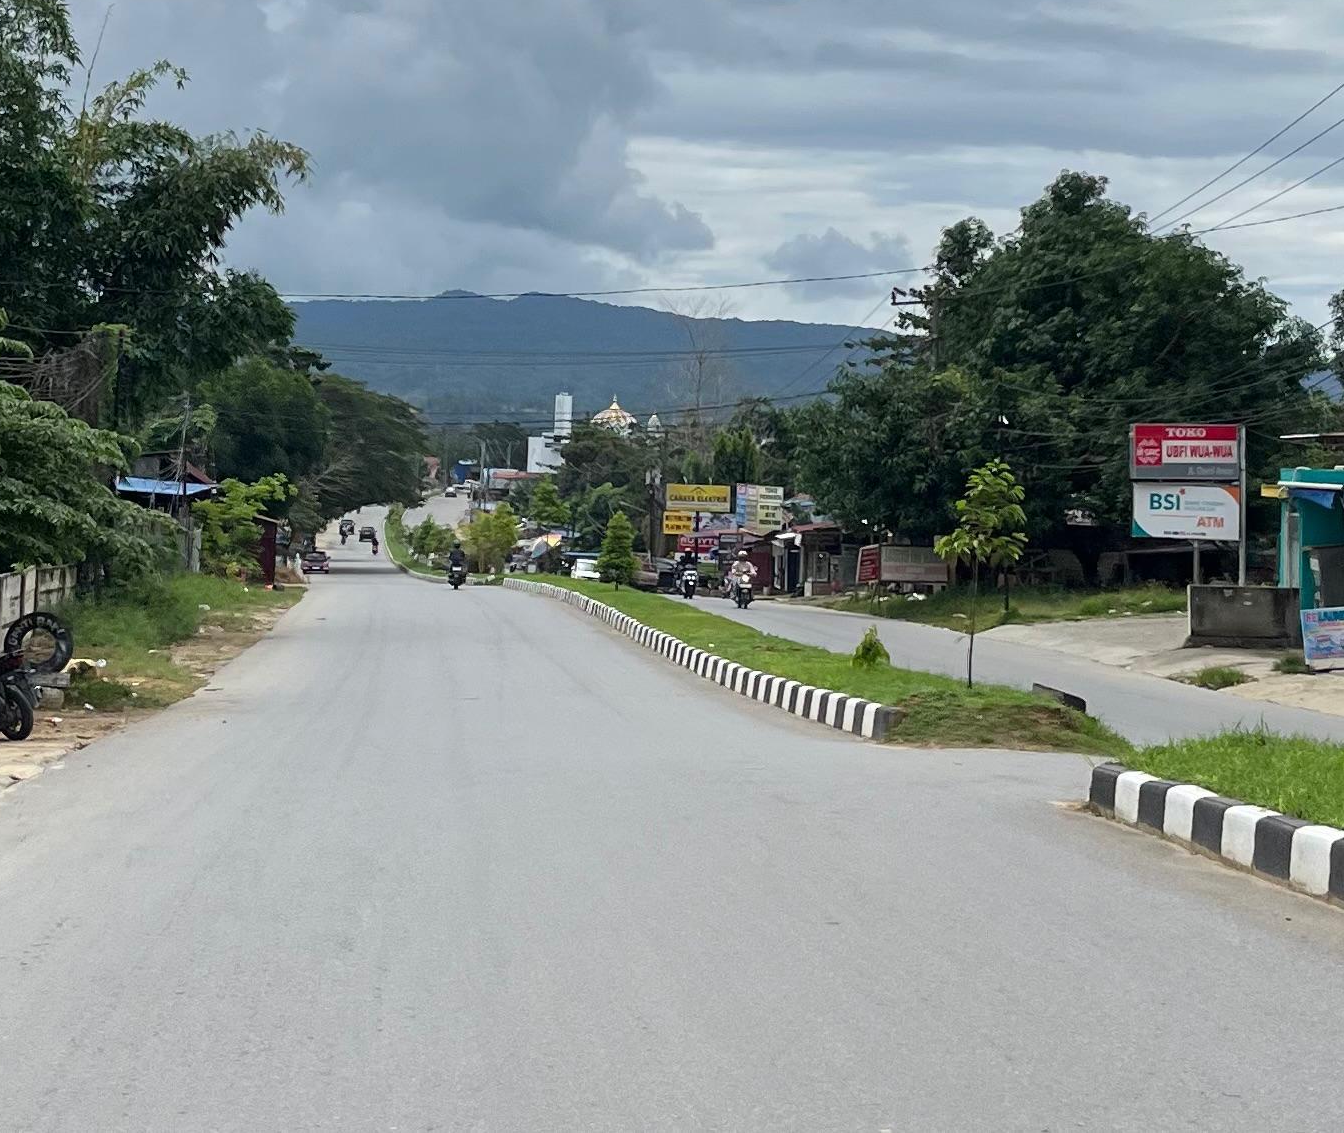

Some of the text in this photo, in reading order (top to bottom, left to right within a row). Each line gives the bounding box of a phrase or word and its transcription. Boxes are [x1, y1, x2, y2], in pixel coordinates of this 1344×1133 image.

[1165, 427, 1207, 438] TOKO
[1190, 445, 1233, 458] WUA-WUA
[1149, 493, 1181, 511] BSI
[1196, 516, 1224, 528] ATM
